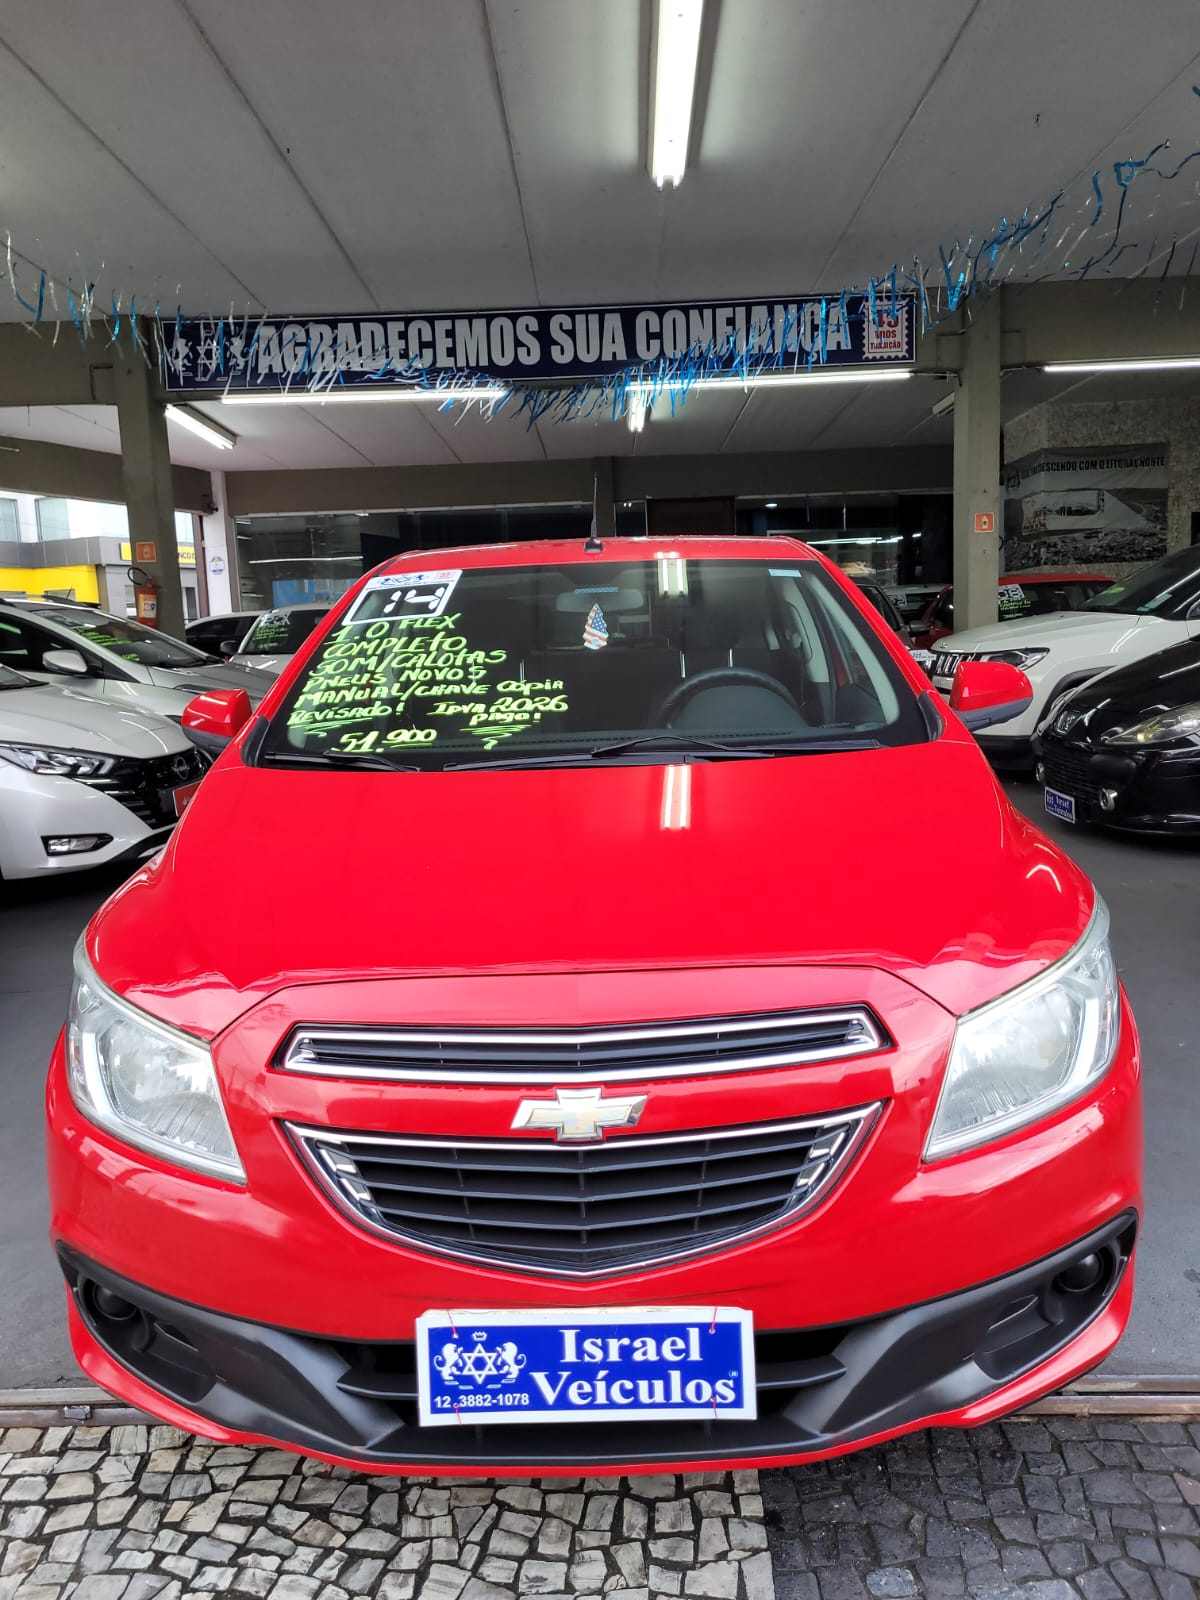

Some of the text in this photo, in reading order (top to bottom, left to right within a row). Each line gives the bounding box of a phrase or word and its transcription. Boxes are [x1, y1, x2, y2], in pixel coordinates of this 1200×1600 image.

[257, 299, 852, 374] AGRADECEMOS SUA CONFIANÇA
[383, 586, 446, 614] 14
[323, 612, 462, 646] 1.0 FLEX
[302, 665, 488, 693] PNEUS NOVOS
[489, 694, 569, 712] 2026
[559, 1326, 704, 1363] Israel
[434, 1392, 530, 1408] 12 3882-1078
[529, 1369, 737, 1406] Veículos
